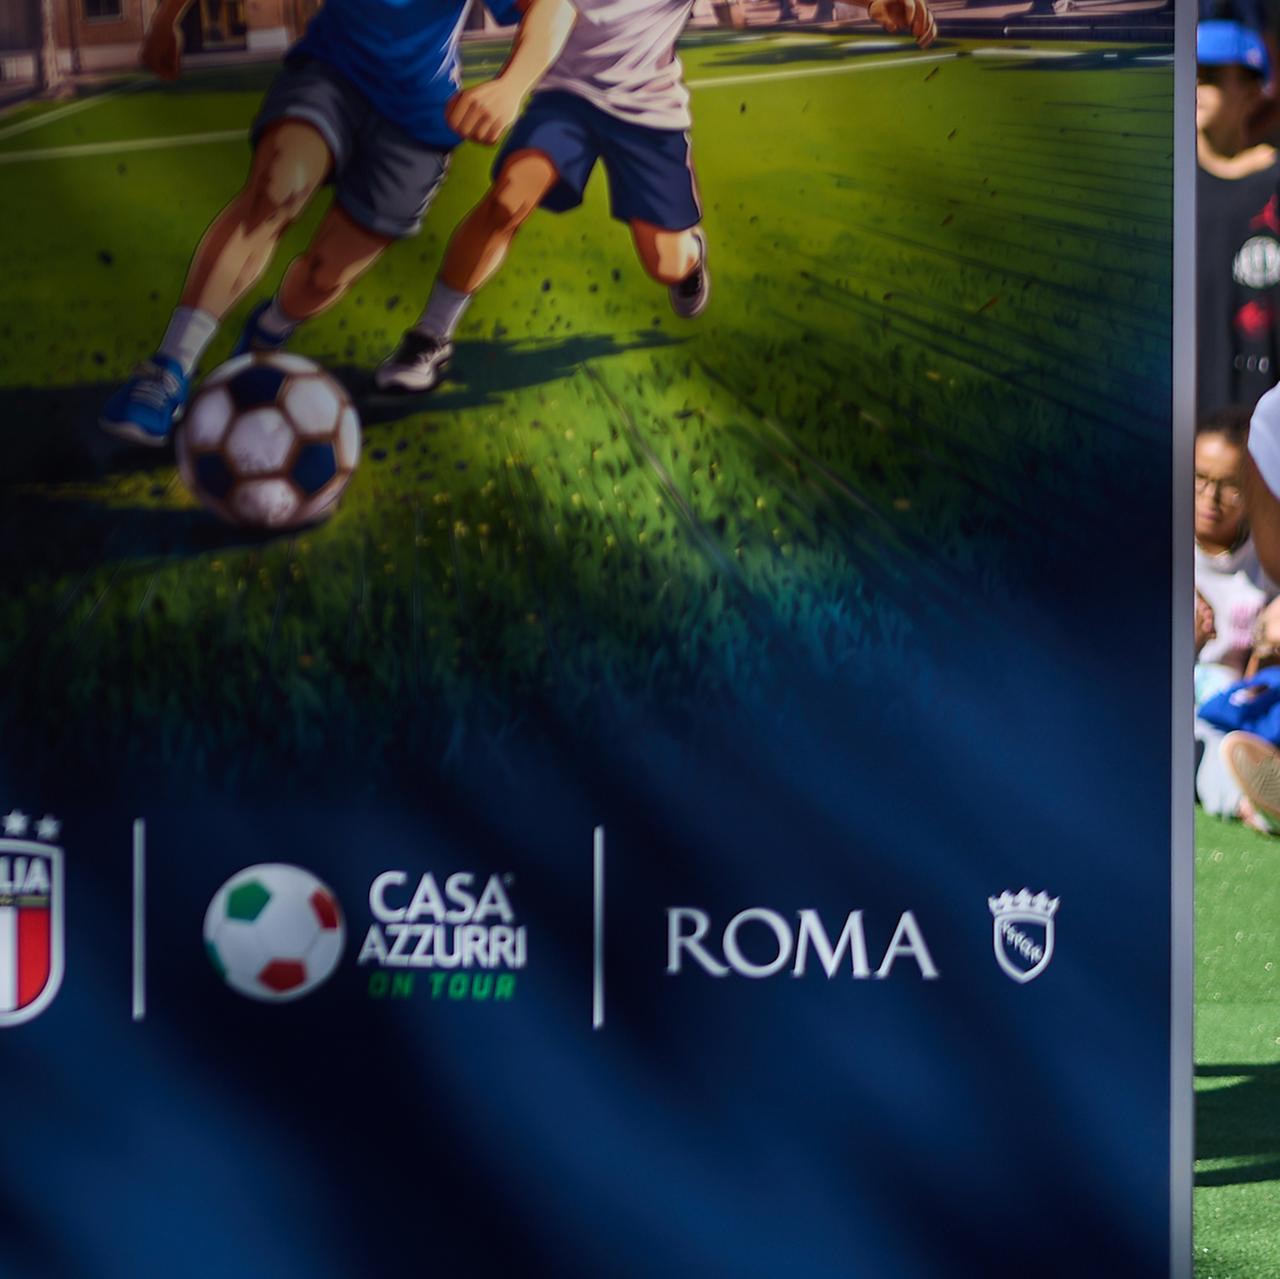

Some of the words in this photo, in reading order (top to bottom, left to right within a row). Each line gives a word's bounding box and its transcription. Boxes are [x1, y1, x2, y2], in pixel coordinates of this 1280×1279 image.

[369, 870, 514, 924] CASA
[357, 923, 528, 969] AZZURRI
[666, 907, 940, 980] ROMA
[370, 972, 416, 1000] ON
[429, 972, 516, 1001] TOUR
